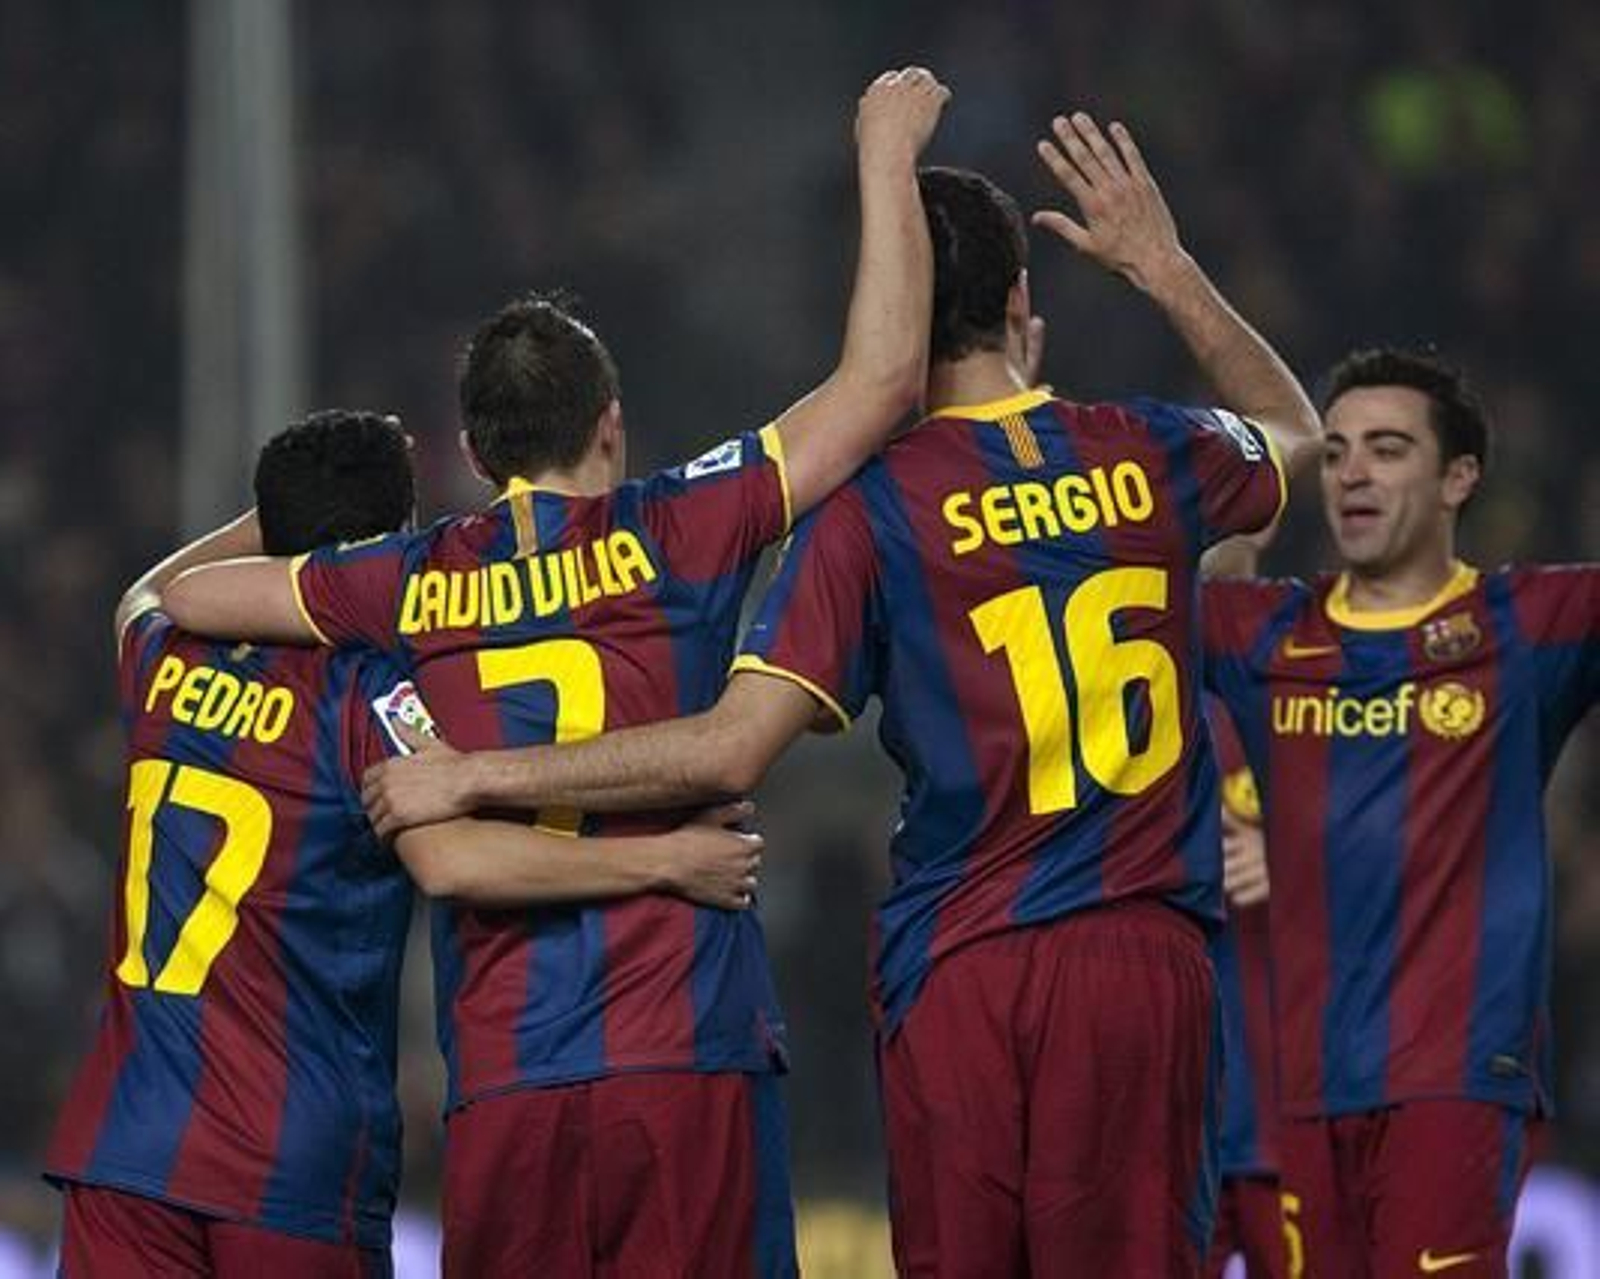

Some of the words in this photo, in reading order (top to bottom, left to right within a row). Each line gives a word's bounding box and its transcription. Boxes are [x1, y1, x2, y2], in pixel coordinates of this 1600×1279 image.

[942, 461, 1154, 555] SERGIO
[526, 529, 656, 617] VILLA
[145, 655, 295, 745] PEDRO
[968, 566, 1183, 815] 16
[1272, 684, 1415, 736] unicef
[477, 639, 606, 838] 7
[116, 758, 273, 996] 17
